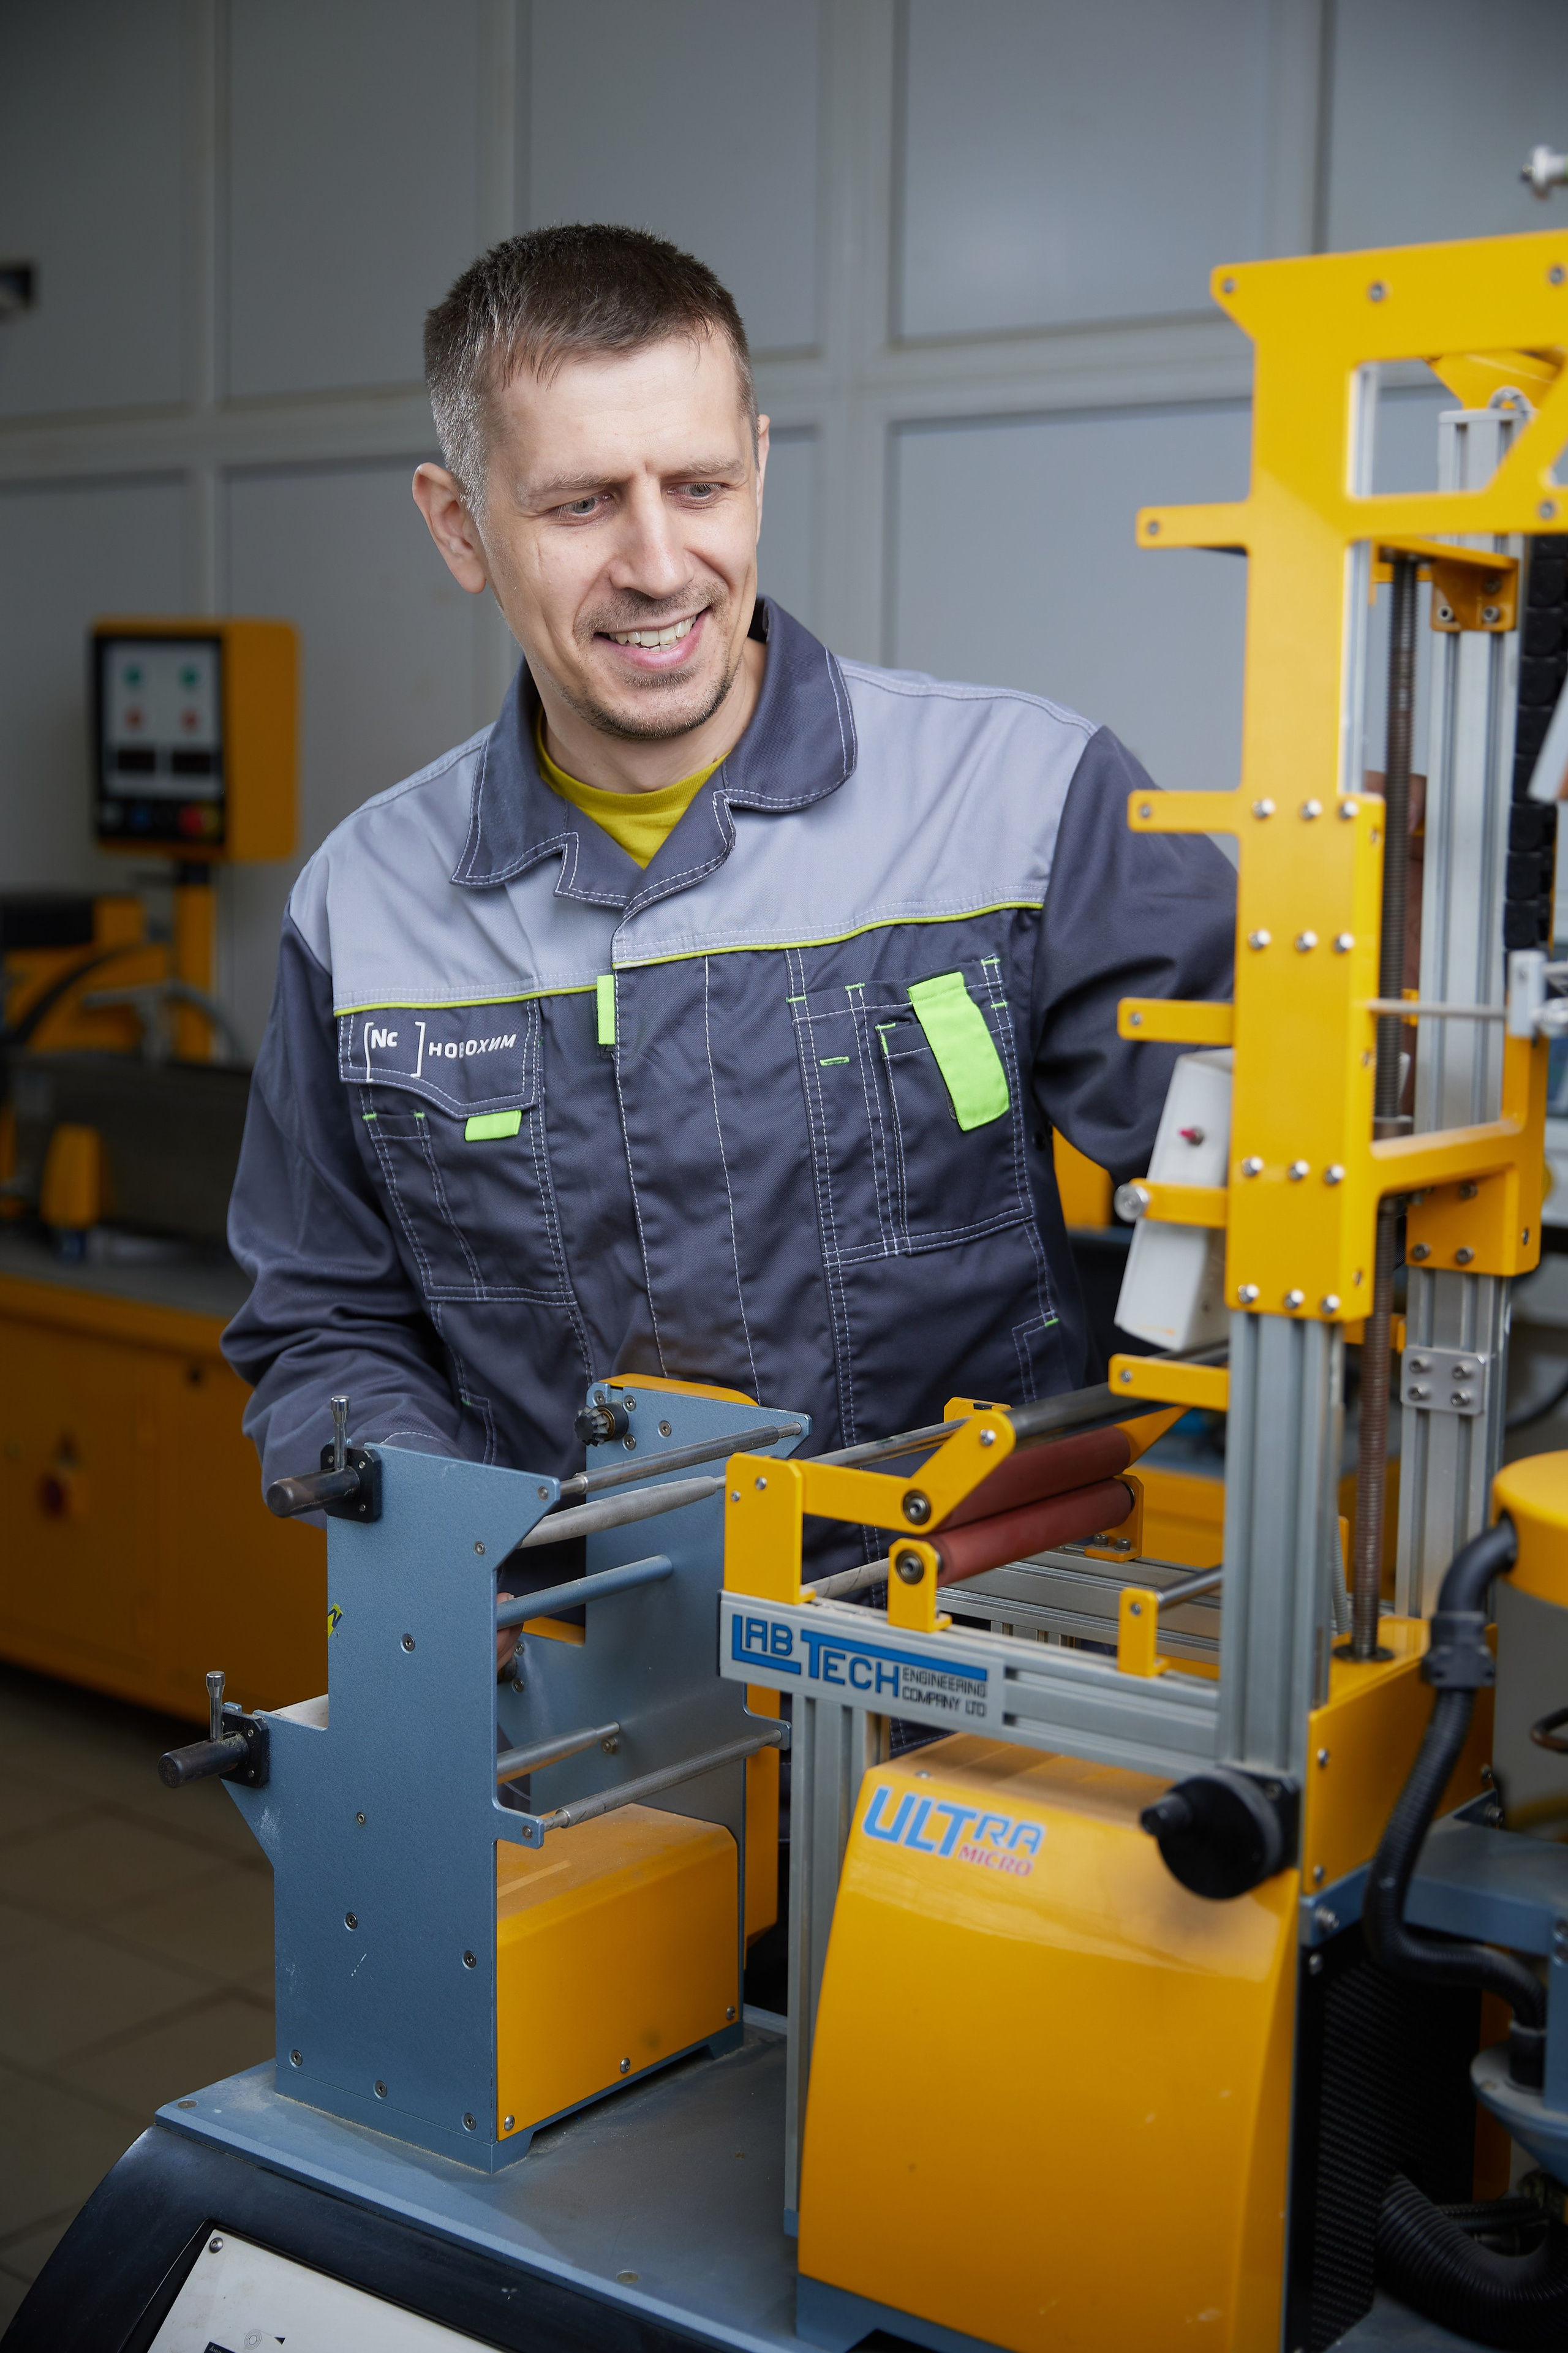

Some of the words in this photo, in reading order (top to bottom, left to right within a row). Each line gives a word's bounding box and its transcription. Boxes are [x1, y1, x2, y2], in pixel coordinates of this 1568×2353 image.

[902, 1667, 987, 1699] ENGINEERING
[902, 1686, 960, 1712] COMPANY
[965, 1699, 987, 1717] LTD
[862, 1784, 1045, 1857] ULTRA
[958, 1844, 1034, 1878] MICRO
